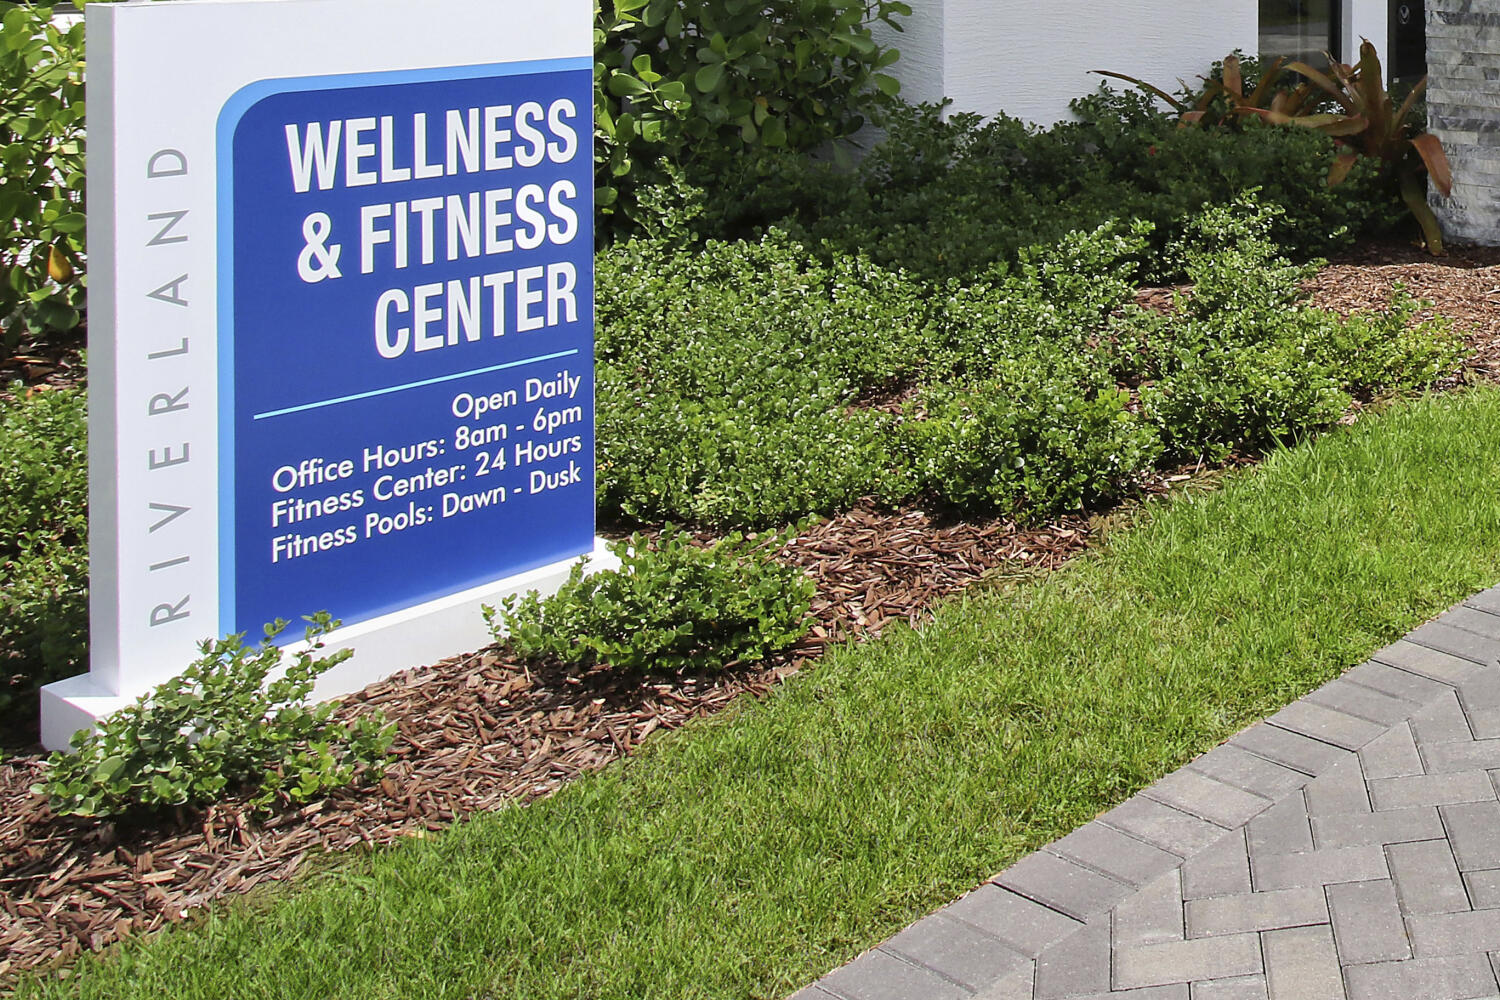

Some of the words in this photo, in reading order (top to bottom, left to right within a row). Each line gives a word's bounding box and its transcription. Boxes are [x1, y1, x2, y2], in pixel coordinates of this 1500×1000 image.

[286, 98, 577, 193] WELLNESS
[297, 212, 342, 283] &
[360, 179, 577, 275] FITNESS
[375, 261, 578, 359] CENTER
[147, 147, 190, 627] RIVERLAND
[451, 389, 517, 420] Open
[524, 370, 581, 402] Daily
[272, 458, 354, 493] Office
[363, 438, 446, 473] Hours:
[454, 421, 507, 450] 8am
[533, 406, 582, 434] 6pm
[272, 487, 364, 528] Fitness
[373, 463, 467, 501] Center:
[474, 448, 507, 477] 24
[514, 433, 582, 467] Hours
[272, 524, 357, 563] Fitness
[365, 503, 433, 538] Pools:
[442, 485, 506, 518] Dawn
[530, 460, 582, 494] Dusk
